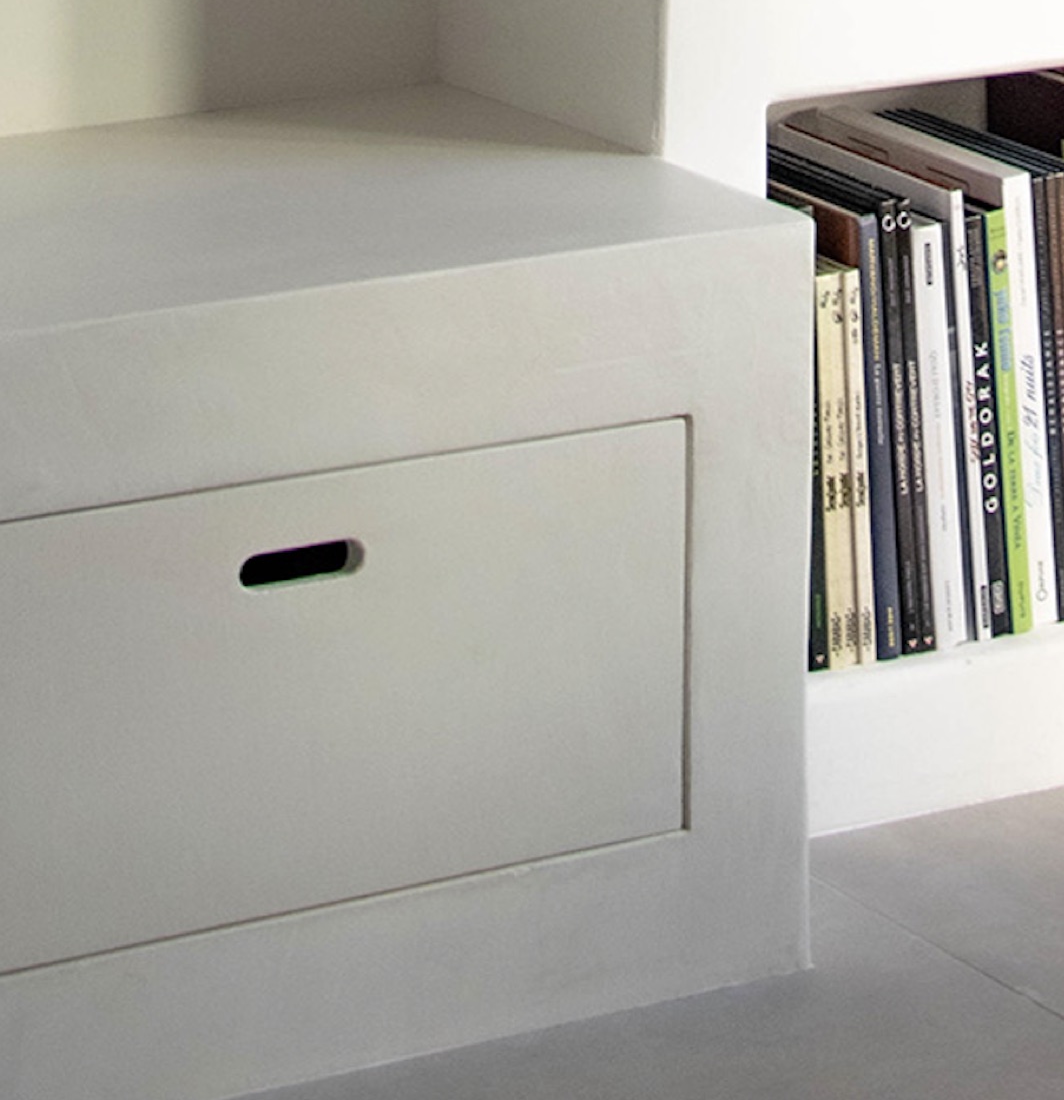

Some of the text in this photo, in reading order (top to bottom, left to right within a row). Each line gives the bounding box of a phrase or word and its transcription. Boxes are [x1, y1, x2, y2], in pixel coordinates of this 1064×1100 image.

[1020, 354, 1036, 402] nuits
[974, 341, 999, 513] GOLDORAK
[1022, 405, 1038, 429] 21
